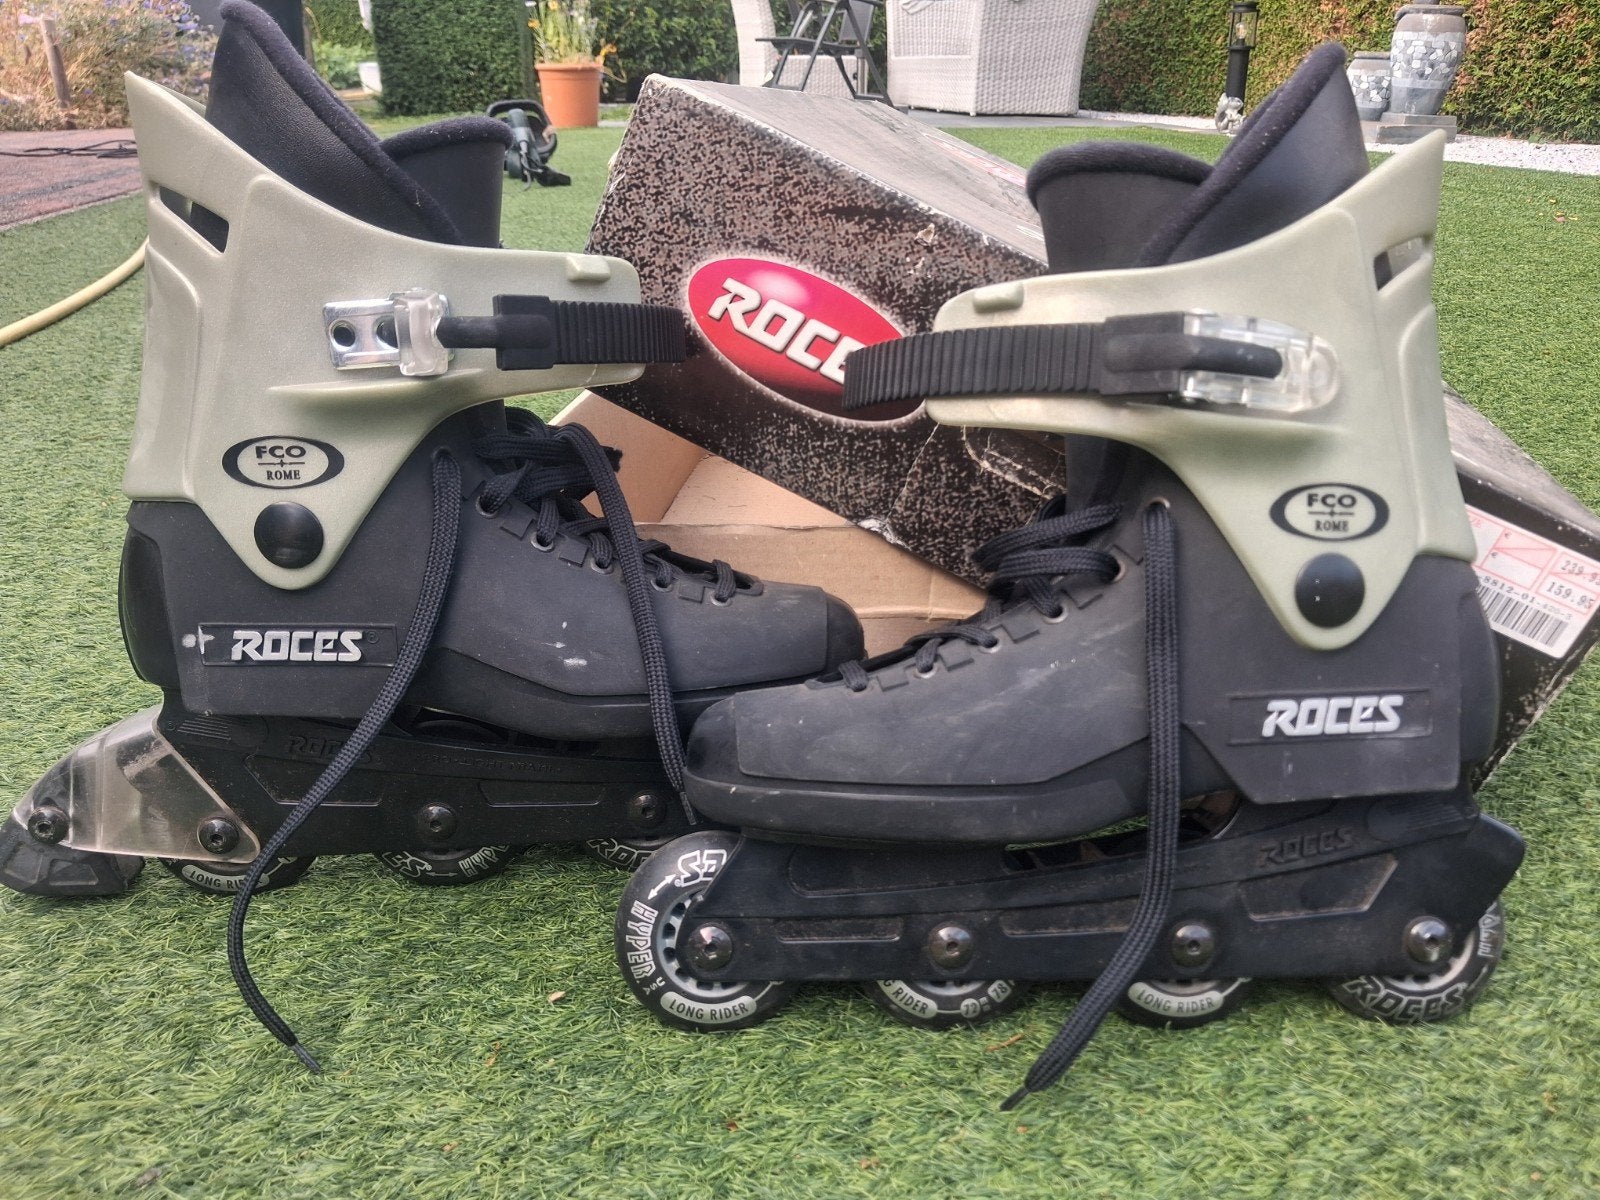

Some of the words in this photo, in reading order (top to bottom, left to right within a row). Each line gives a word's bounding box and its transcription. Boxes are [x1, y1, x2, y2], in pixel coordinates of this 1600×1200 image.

[708, 277, 867, 385] ROCE
[255, 445, 306, 459] FCO
[266, 469, 301, 480] ROME
[1307, 493, 1357, 508] FCO
[1314, 520, 1349, 531] ROME
[1546, 581, 1595, 610] 159.95
[231, 630, 363, 661] ROCES
[1262, 695, 1404, 737] ROCES
[1261, 827, 1355, 866] ROCES
[190, 870, 221, 888] LONG
[625, 900, 658, 979] HYPER
[645, 976, 666, 995] USA
[992, 984, 1008, 1000] 78
[893, 987, 929, 1014] RIDER
[964, 1003, 978, 1016] 72
[1137, 989, 1171, 1011] LONG
[1177, 997, 1214, 1013] RIDER
[1341, 976, 1467, 1021] ROCES
[669, 1000, 704, 1019] LONG
[710, 1003, 749, 1020] RIDER
